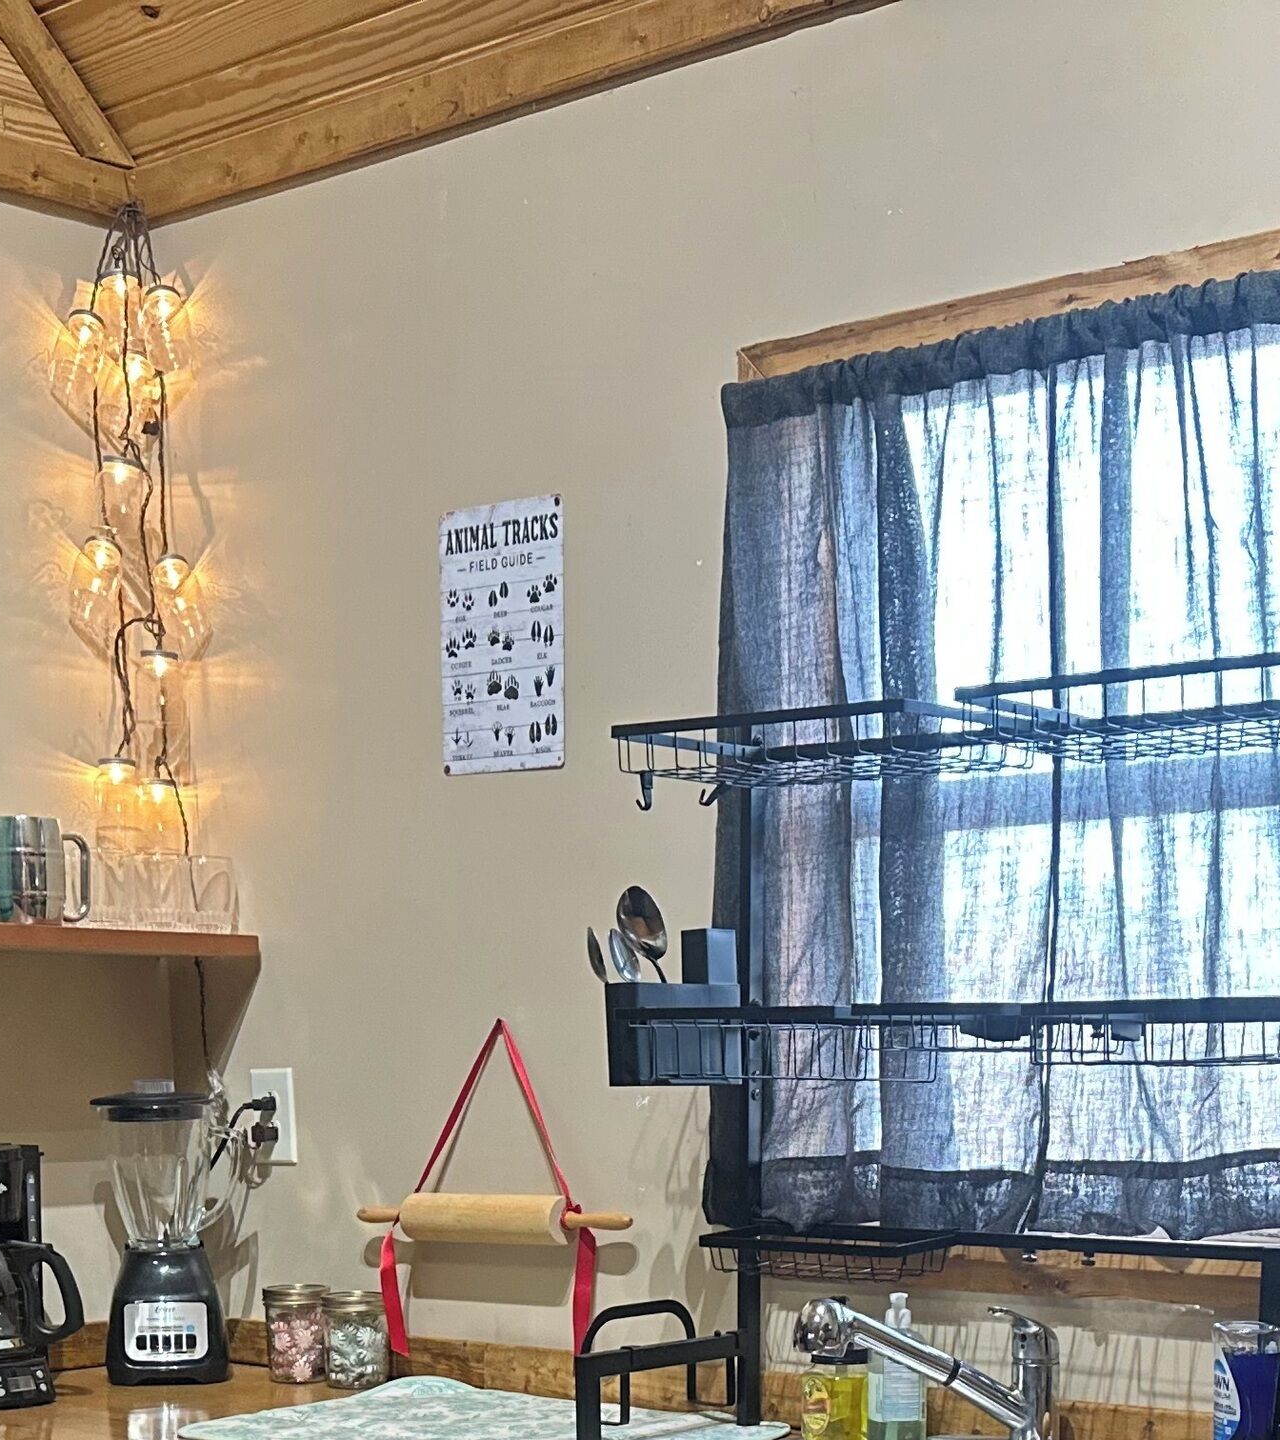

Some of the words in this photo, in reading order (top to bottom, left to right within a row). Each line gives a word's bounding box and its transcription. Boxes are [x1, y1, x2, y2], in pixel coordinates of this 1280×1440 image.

[445, 521, 497, 556] ANIMAL
[502, 512, 559, 547] TRACKS
[469, 556, 498, 573] FIELD
[501, 551, 533, 569] GUIDE
